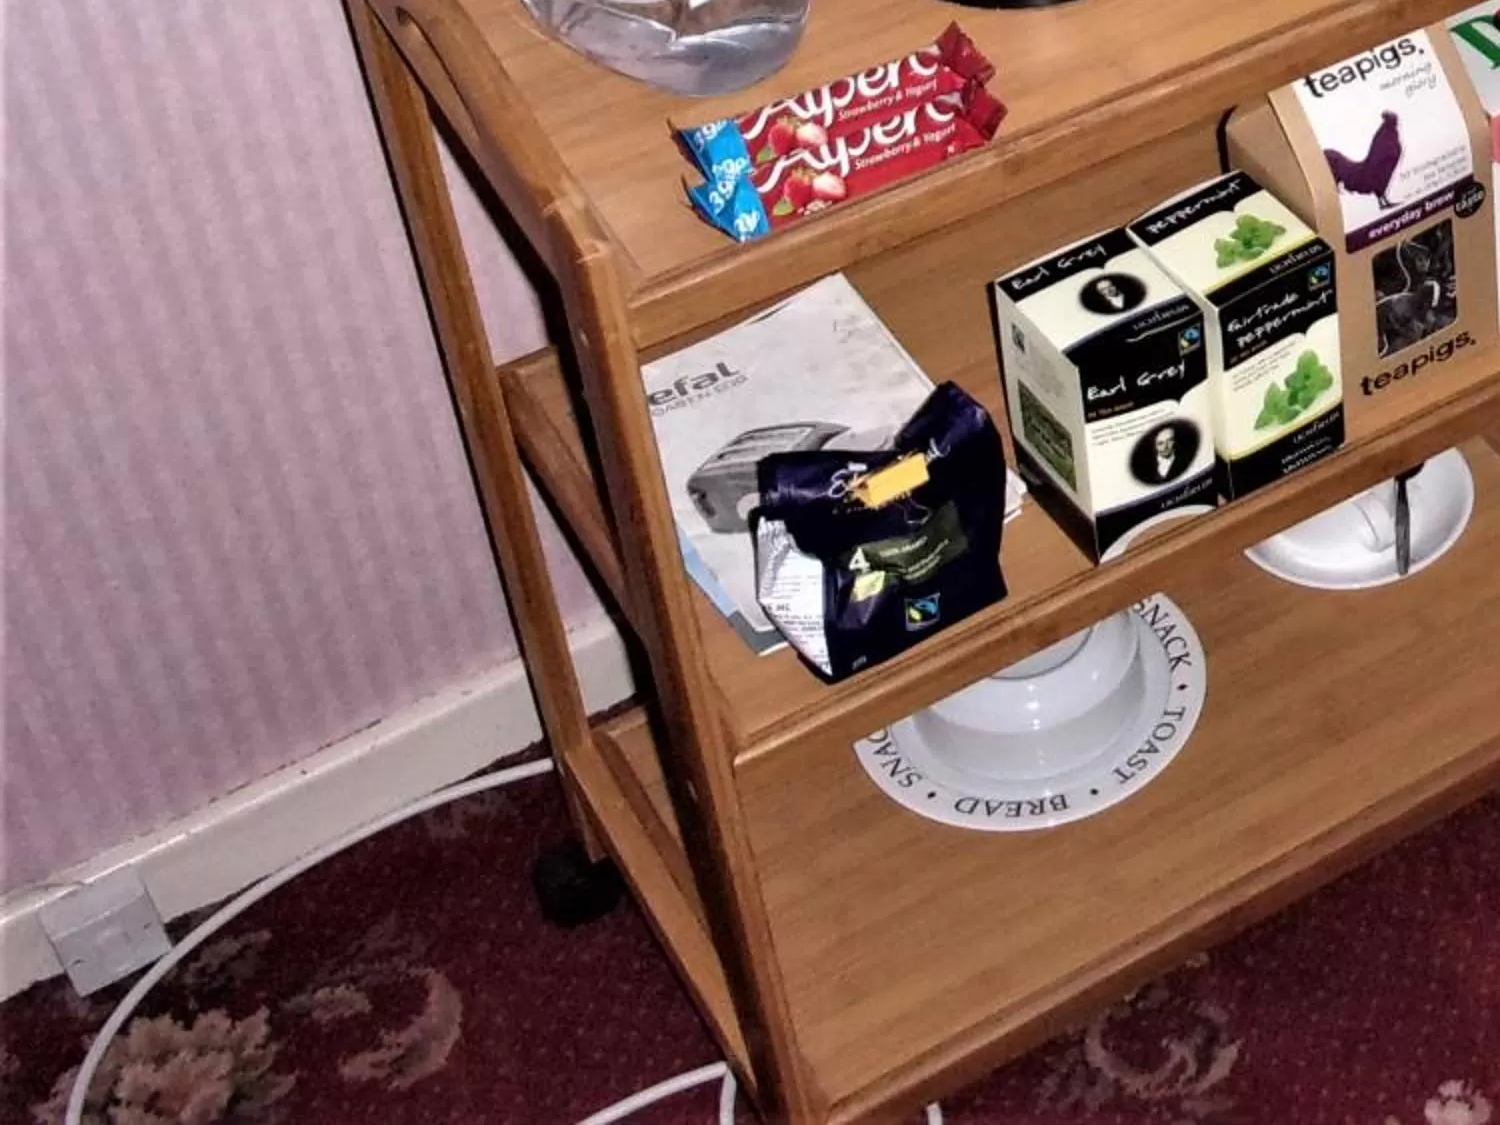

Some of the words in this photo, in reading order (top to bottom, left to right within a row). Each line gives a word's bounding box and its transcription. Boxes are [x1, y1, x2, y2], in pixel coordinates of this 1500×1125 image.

[854, 141, 912, 171] Strawberry
[922, 122, 956, 143] Yogurt
[1367, 208, 1422, 238] everyday
[1424, 190, 1456, 212] brew
[1011, 266, 1051, 292] Earl
[1056, 243, 1108, 270] Grey
[647, 361, 741, 406] efal
[1087, 375, 1127, 401] Earl
[1136, 359, 1186, 387] Grey
[867, 729, 923, 788] SNAC
[1113, 705, 1187, 785] TOAST
[953, 793, 1071, 819] BREAD
